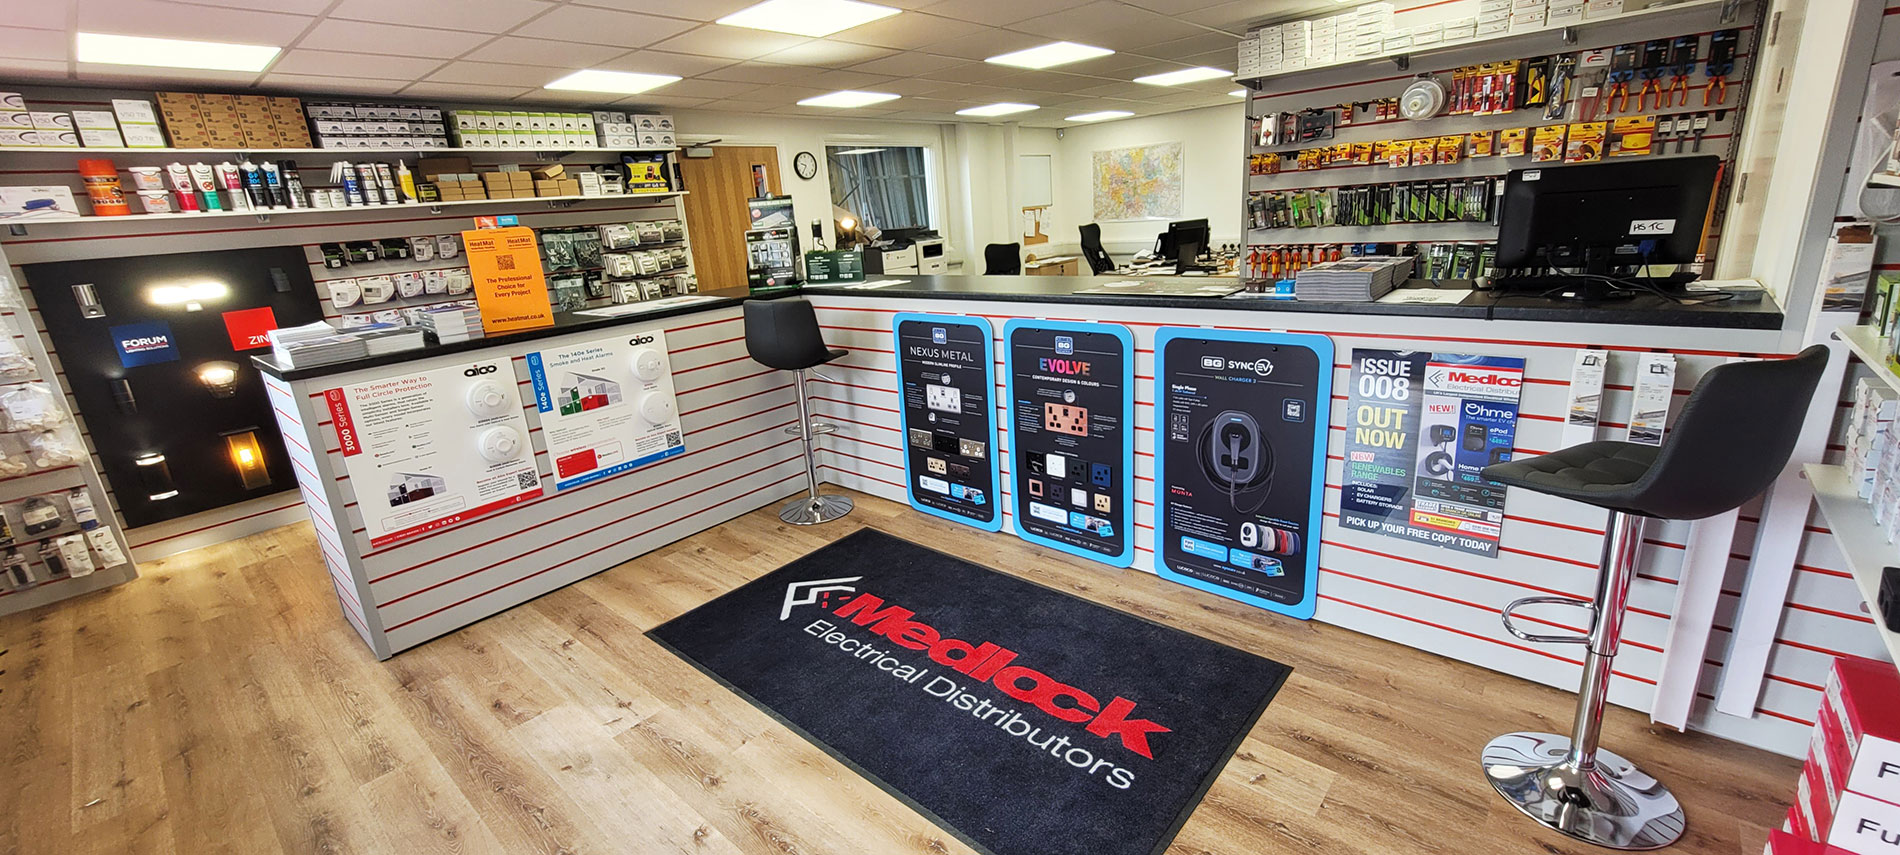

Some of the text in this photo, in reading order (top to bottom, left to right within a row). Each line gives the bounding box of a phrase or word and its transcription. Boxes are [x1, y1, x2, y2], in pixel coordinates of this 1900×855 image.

[492, 314, 544, 324] www.heatmat.co.uk
[122, 335, 168, 348] FORUM
[248, 334, 270, 345] ZIN
[629, 335, 654, 346] aico
[910, 346, 974, 362] NEXUS METAL
[464, 364, 497, 377] aico
[1040, 357, 1091, 376] EVOLVE
[1204, 359, 1222, 368] BG
[1360, 357, 1412, 377] ISSUE
[535, 369, 544, 391] Series
[1032, 374, 1061, 383] CONTEMPORARY
[1448, 372, 1522, 387] Medloc
[370, 382, 399, 391] Smarter
[372, 390, 393, 398] Circle
[395, 382, 432, 393] Protection
[1358, 374, 1410, 401] 008
[1447, 383, 1484, 393] Electrical
[540, 392, 549, 410] 140e
[335, 403, 348, 428] Series
[1429, 405, 1456, 414] NEW!
[1466, 402, 1513, 419] Ohme
[1357, 405, 1408, 430] OUT
[341, 429, 355, 452] 3000
[1355, 428, 1406, 450] NOW
[1352, 452, 1374, 462] NEW
[1352, 462, 1406, 477] RENEWABLES
[1352, 471, 1379, 481] RANGE
[1171, 489, 1192, 497] MONTA
[1366, 493, 1392, 502] CHARGERS
[1356, 498, 1403, 510] BATTERY STORAGE
[1346, 516, 1492, 551] PICK UP YOUR FREE COPY TODAY
[832, 592, 1172, 760] Medlock
[803, 618, 1135, 790] Electrical Distributors
